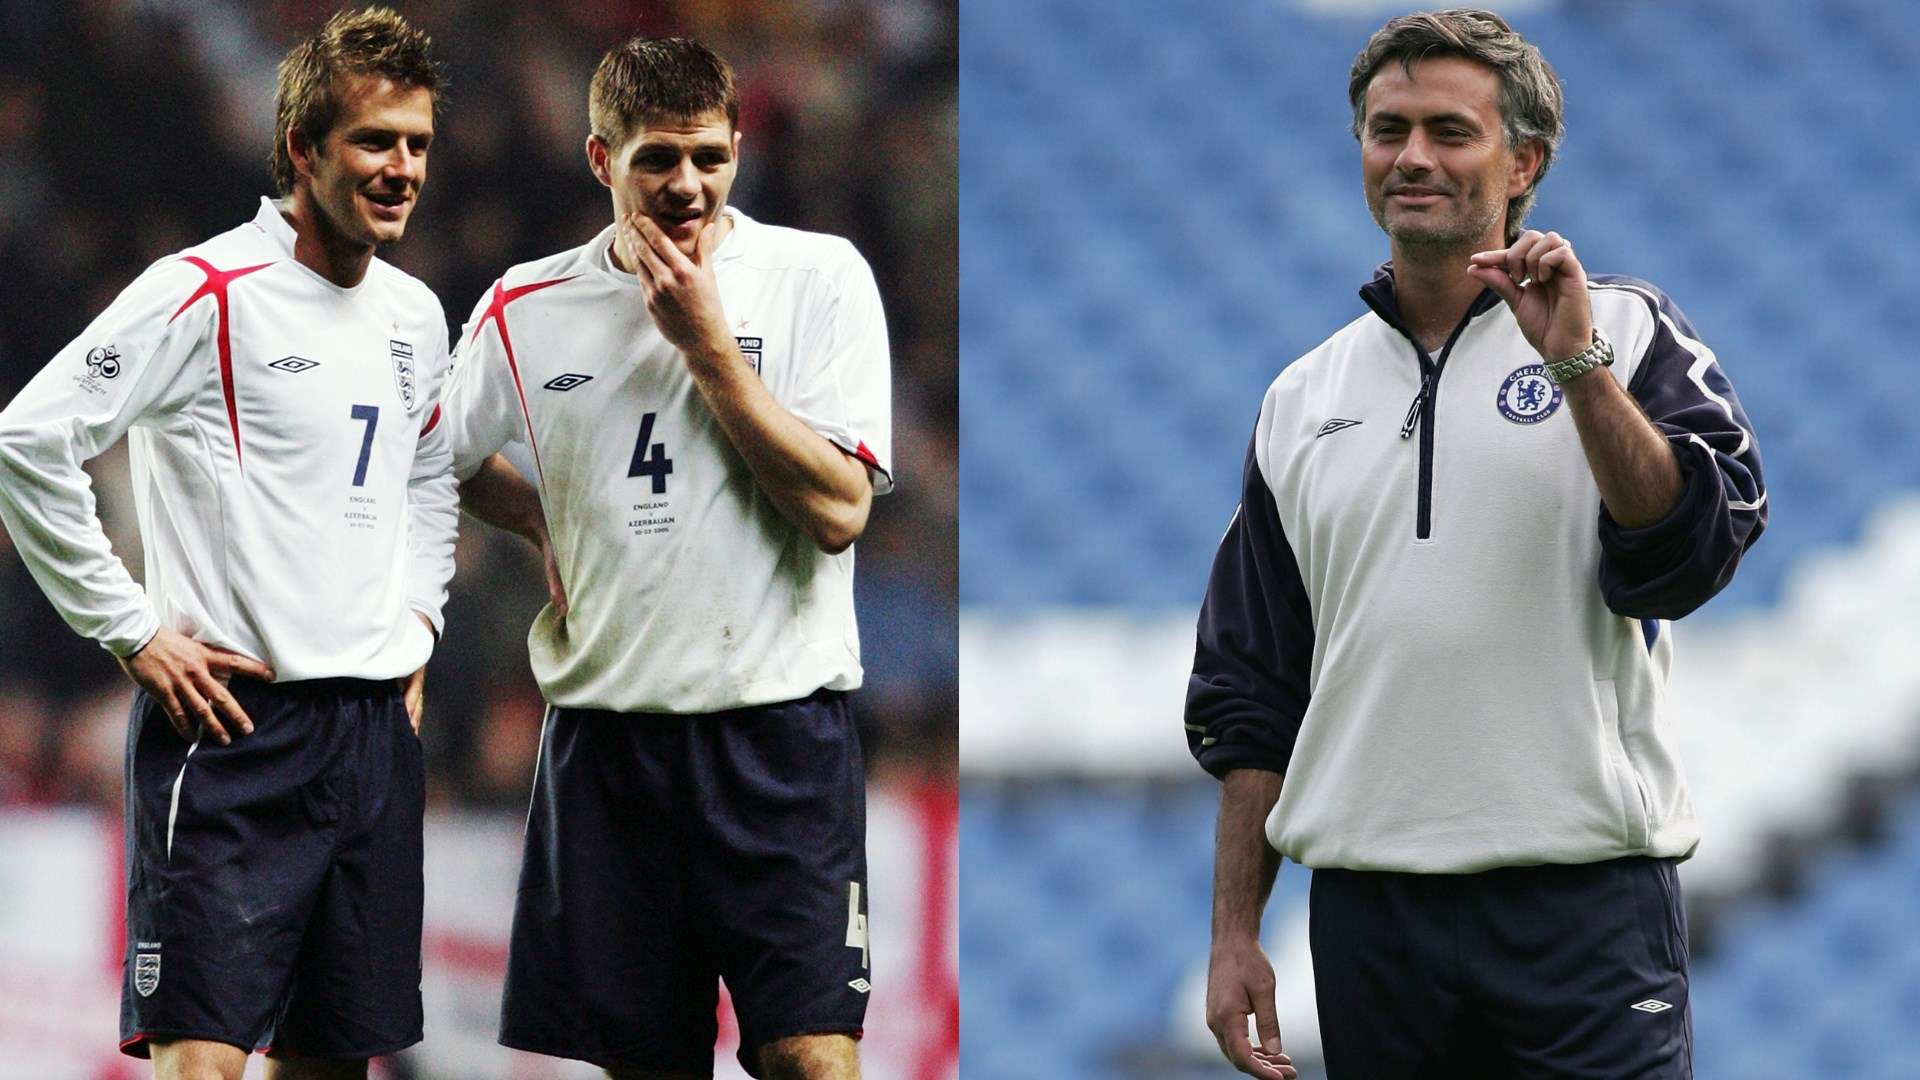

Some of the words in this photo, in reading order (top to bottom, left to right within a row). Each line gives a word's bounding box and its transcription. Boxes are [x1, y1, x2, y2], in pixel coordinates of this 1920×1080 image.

[351, 404, 379, 487] 7
[627, 412, 674, 494] 4
[628, 517, 675, 527] AZERBAIJAN
[633, 502, 669, 511] ENGLAND
[845, 881, 868, 969] 4
